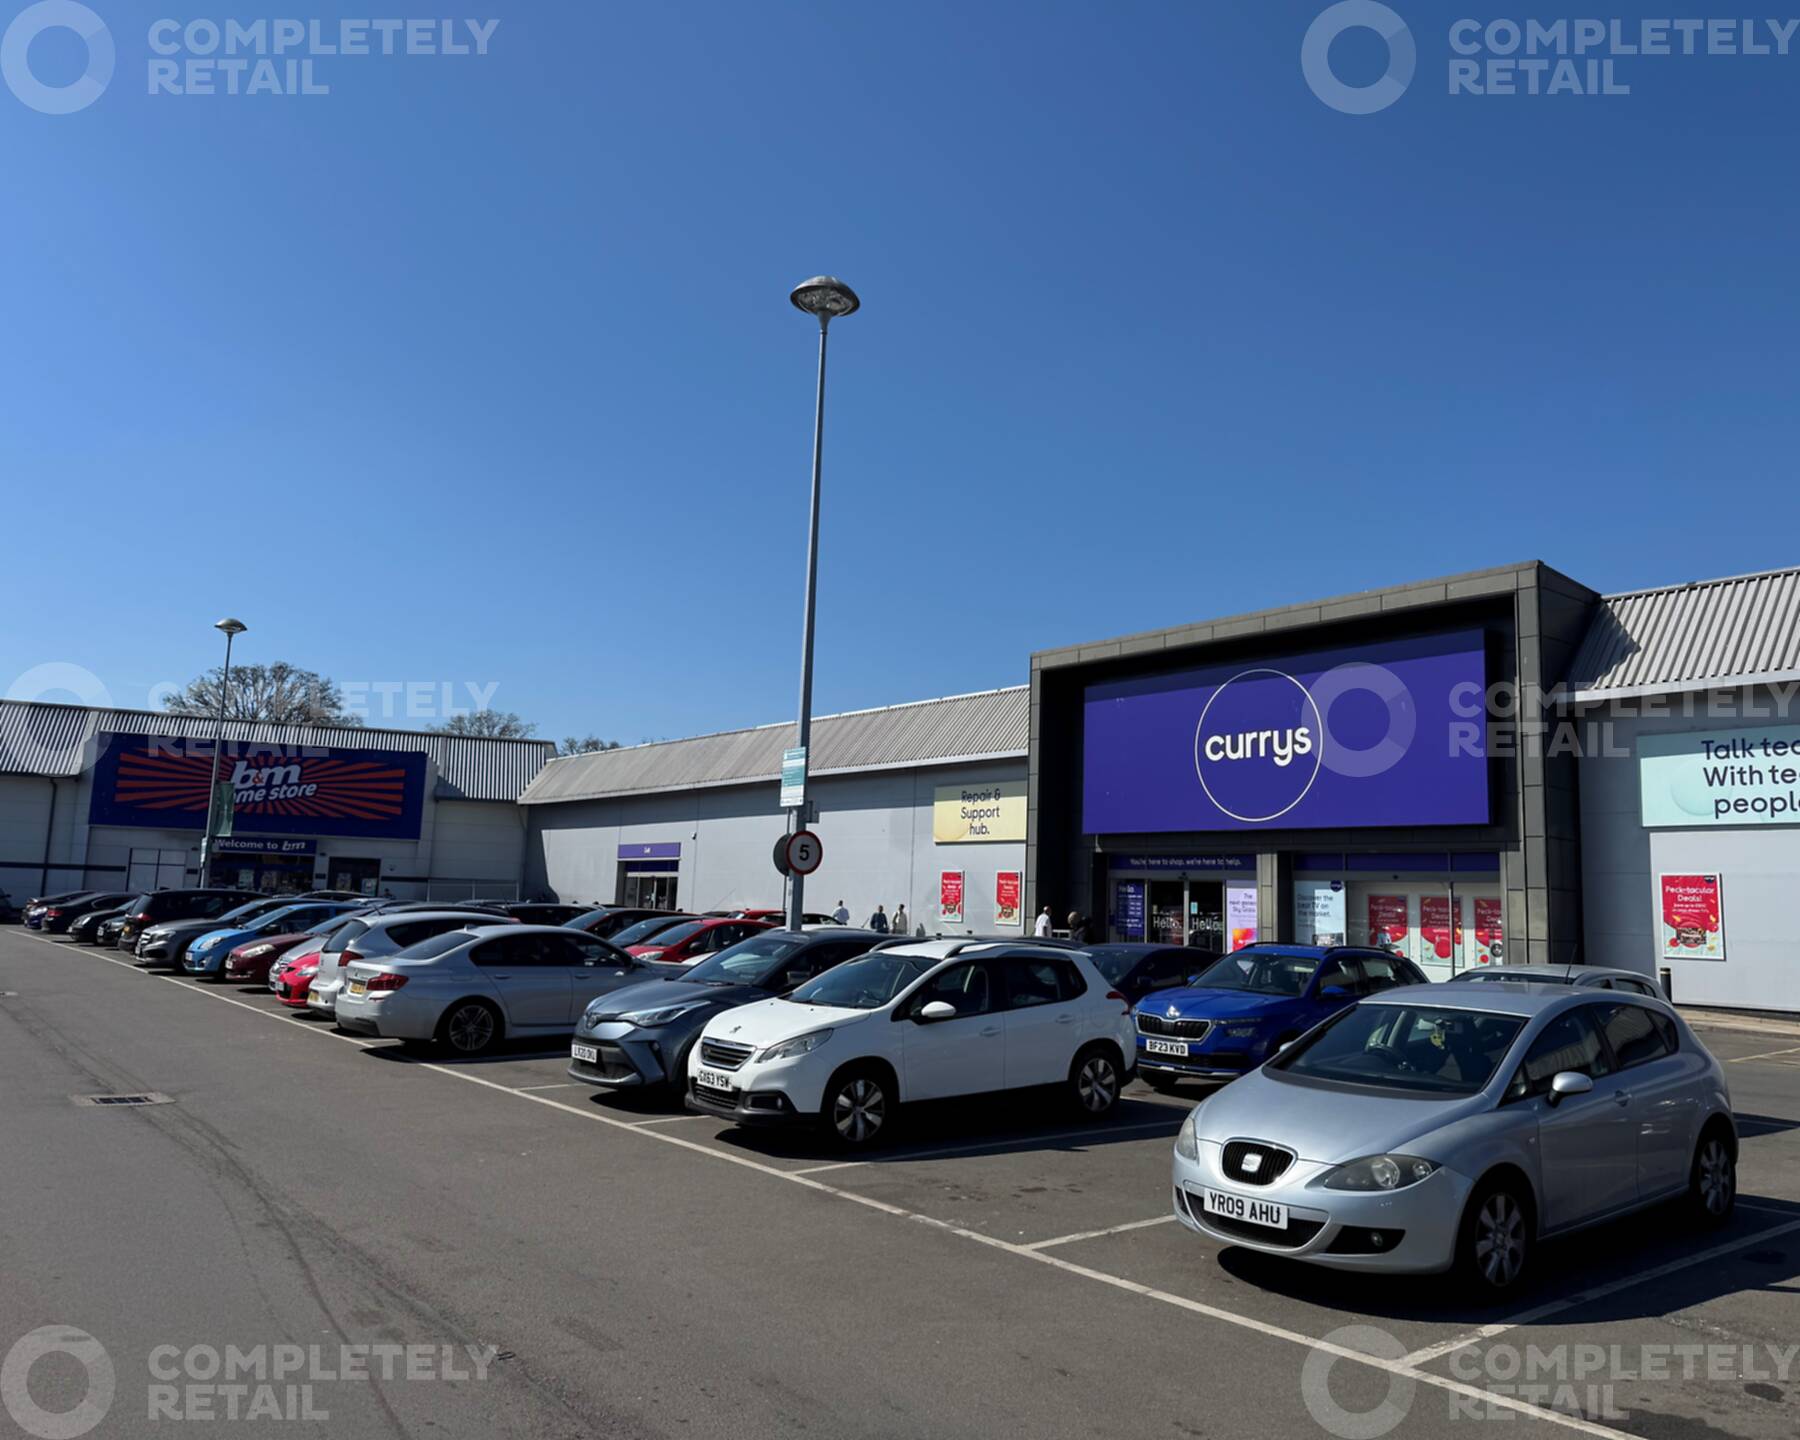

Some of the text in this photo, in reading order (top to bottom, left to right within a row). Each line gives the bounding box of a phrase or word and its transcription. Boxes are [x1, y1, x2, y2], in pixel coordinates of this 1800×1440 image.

[1205, 727, 1312, 767] currys
[1701, 738, 1755, 760] Talk
[1703, 765, 1763, 787] With
[268, 783, 318, 800] store
[961, 789, 991, 804] Repair
[1715, 790, 1800, 819] peopl
[961, 806, 1000, 821] Support
[969, 823, 990, 835] hub.
[215, 839, 264, 849] Welcome
[267, 841, 278, 849] to
[799, 844, 810, 861] 5
[1665, 885, 1715, 894] Peck-tacular
[1677, 894, 1703, 902] Deals!
[1153, 916, 1182, 929] Hello.
[1210, 1192, 1281, 1224] YR09 AHU
